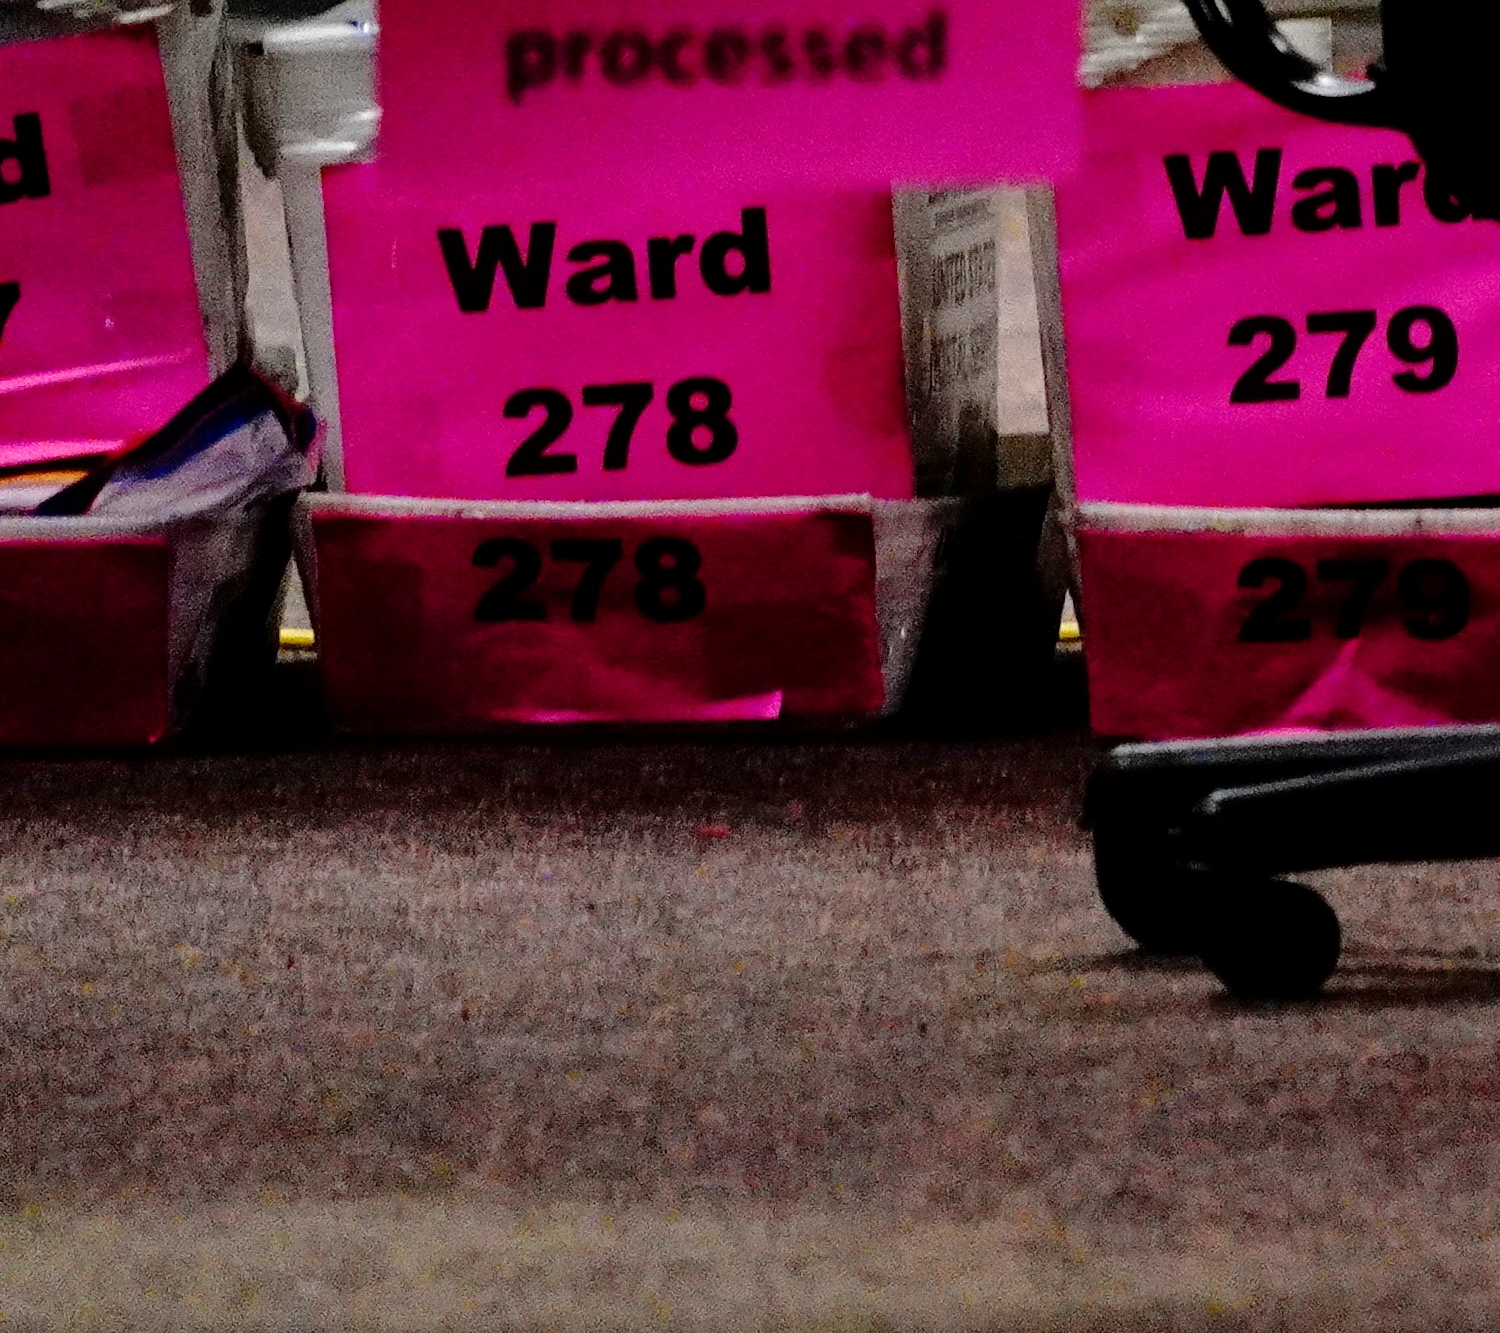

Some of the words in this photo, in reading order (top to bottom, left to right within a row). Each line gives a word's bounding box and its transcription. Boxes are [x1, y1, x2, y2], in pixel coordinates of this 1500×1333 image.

[503, 11, 947, 105] processed
[437, 207, 771, 313] Ward
[1228, 306, 1458, 403] 279
[504, 377, 738, 477] 278
[472, 536, 707, 624] 278
[1238, 558, 1470, 643] 279
